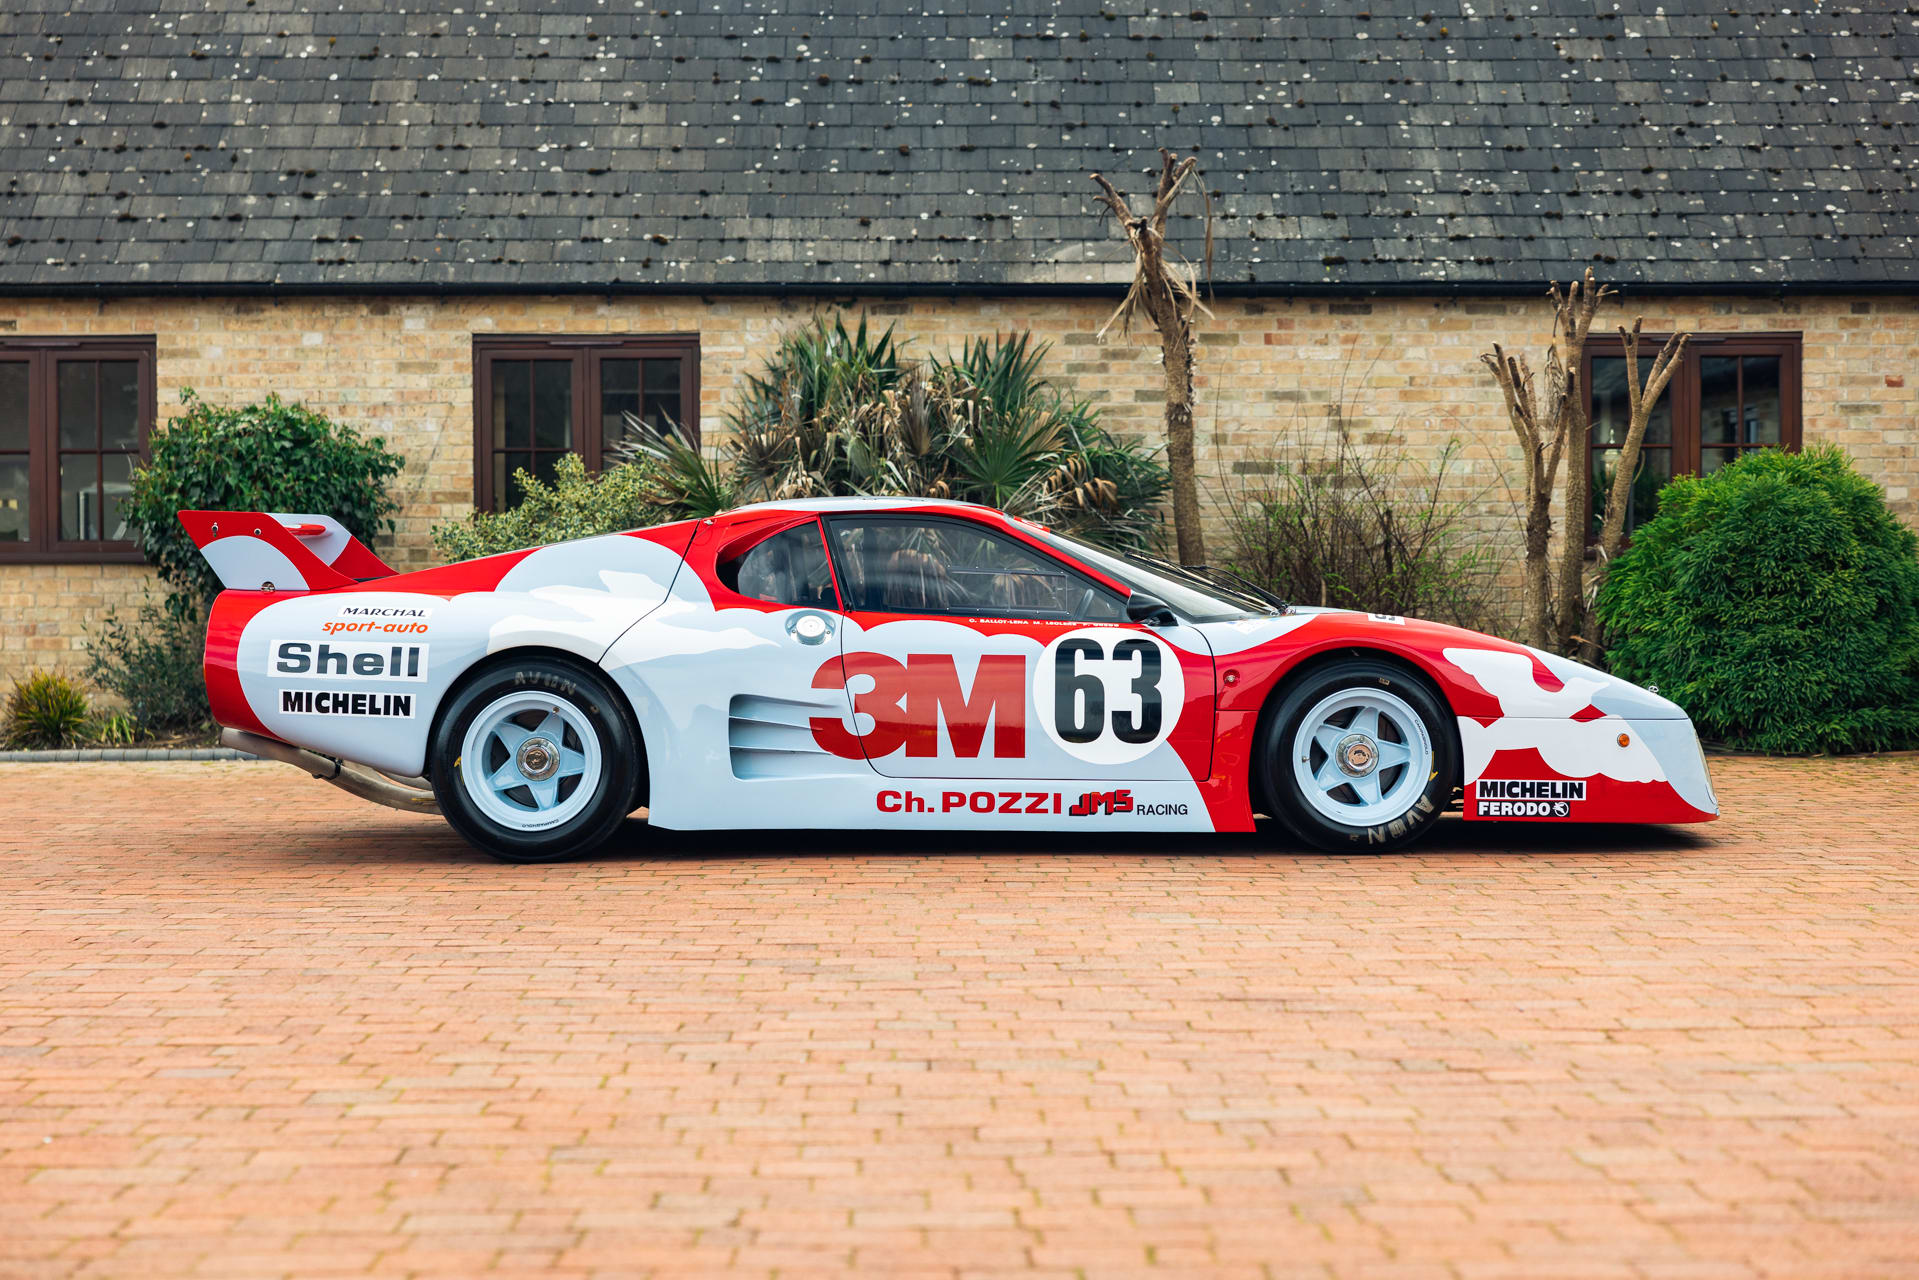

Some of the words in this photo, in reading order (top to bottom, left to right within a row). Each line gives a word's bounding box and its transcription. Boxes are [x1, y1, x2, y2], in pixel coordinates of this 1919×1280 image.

[343, 607, 426, 617] MARCHAL
[322, 621, 428, 635] sport-auto
[277, 642, 420, 677] Shell
[282, 691, 411, 716] MICHELIN
[1055, 638, 1162, 744] 63
[809, 651, 1026, 760] 3M
[876, 790, 934, 813] Ch.
[942, 791, 1061, 814] POZZI
[1069, 789, 1134, 816] JMS
[1136, 804, 1188, 815] RACING
[1479, 781, 1583, 799] MICHELIN
[1367, 794, 1434, 845] AVON
[1478, 801, 1551, 816] FERODO
